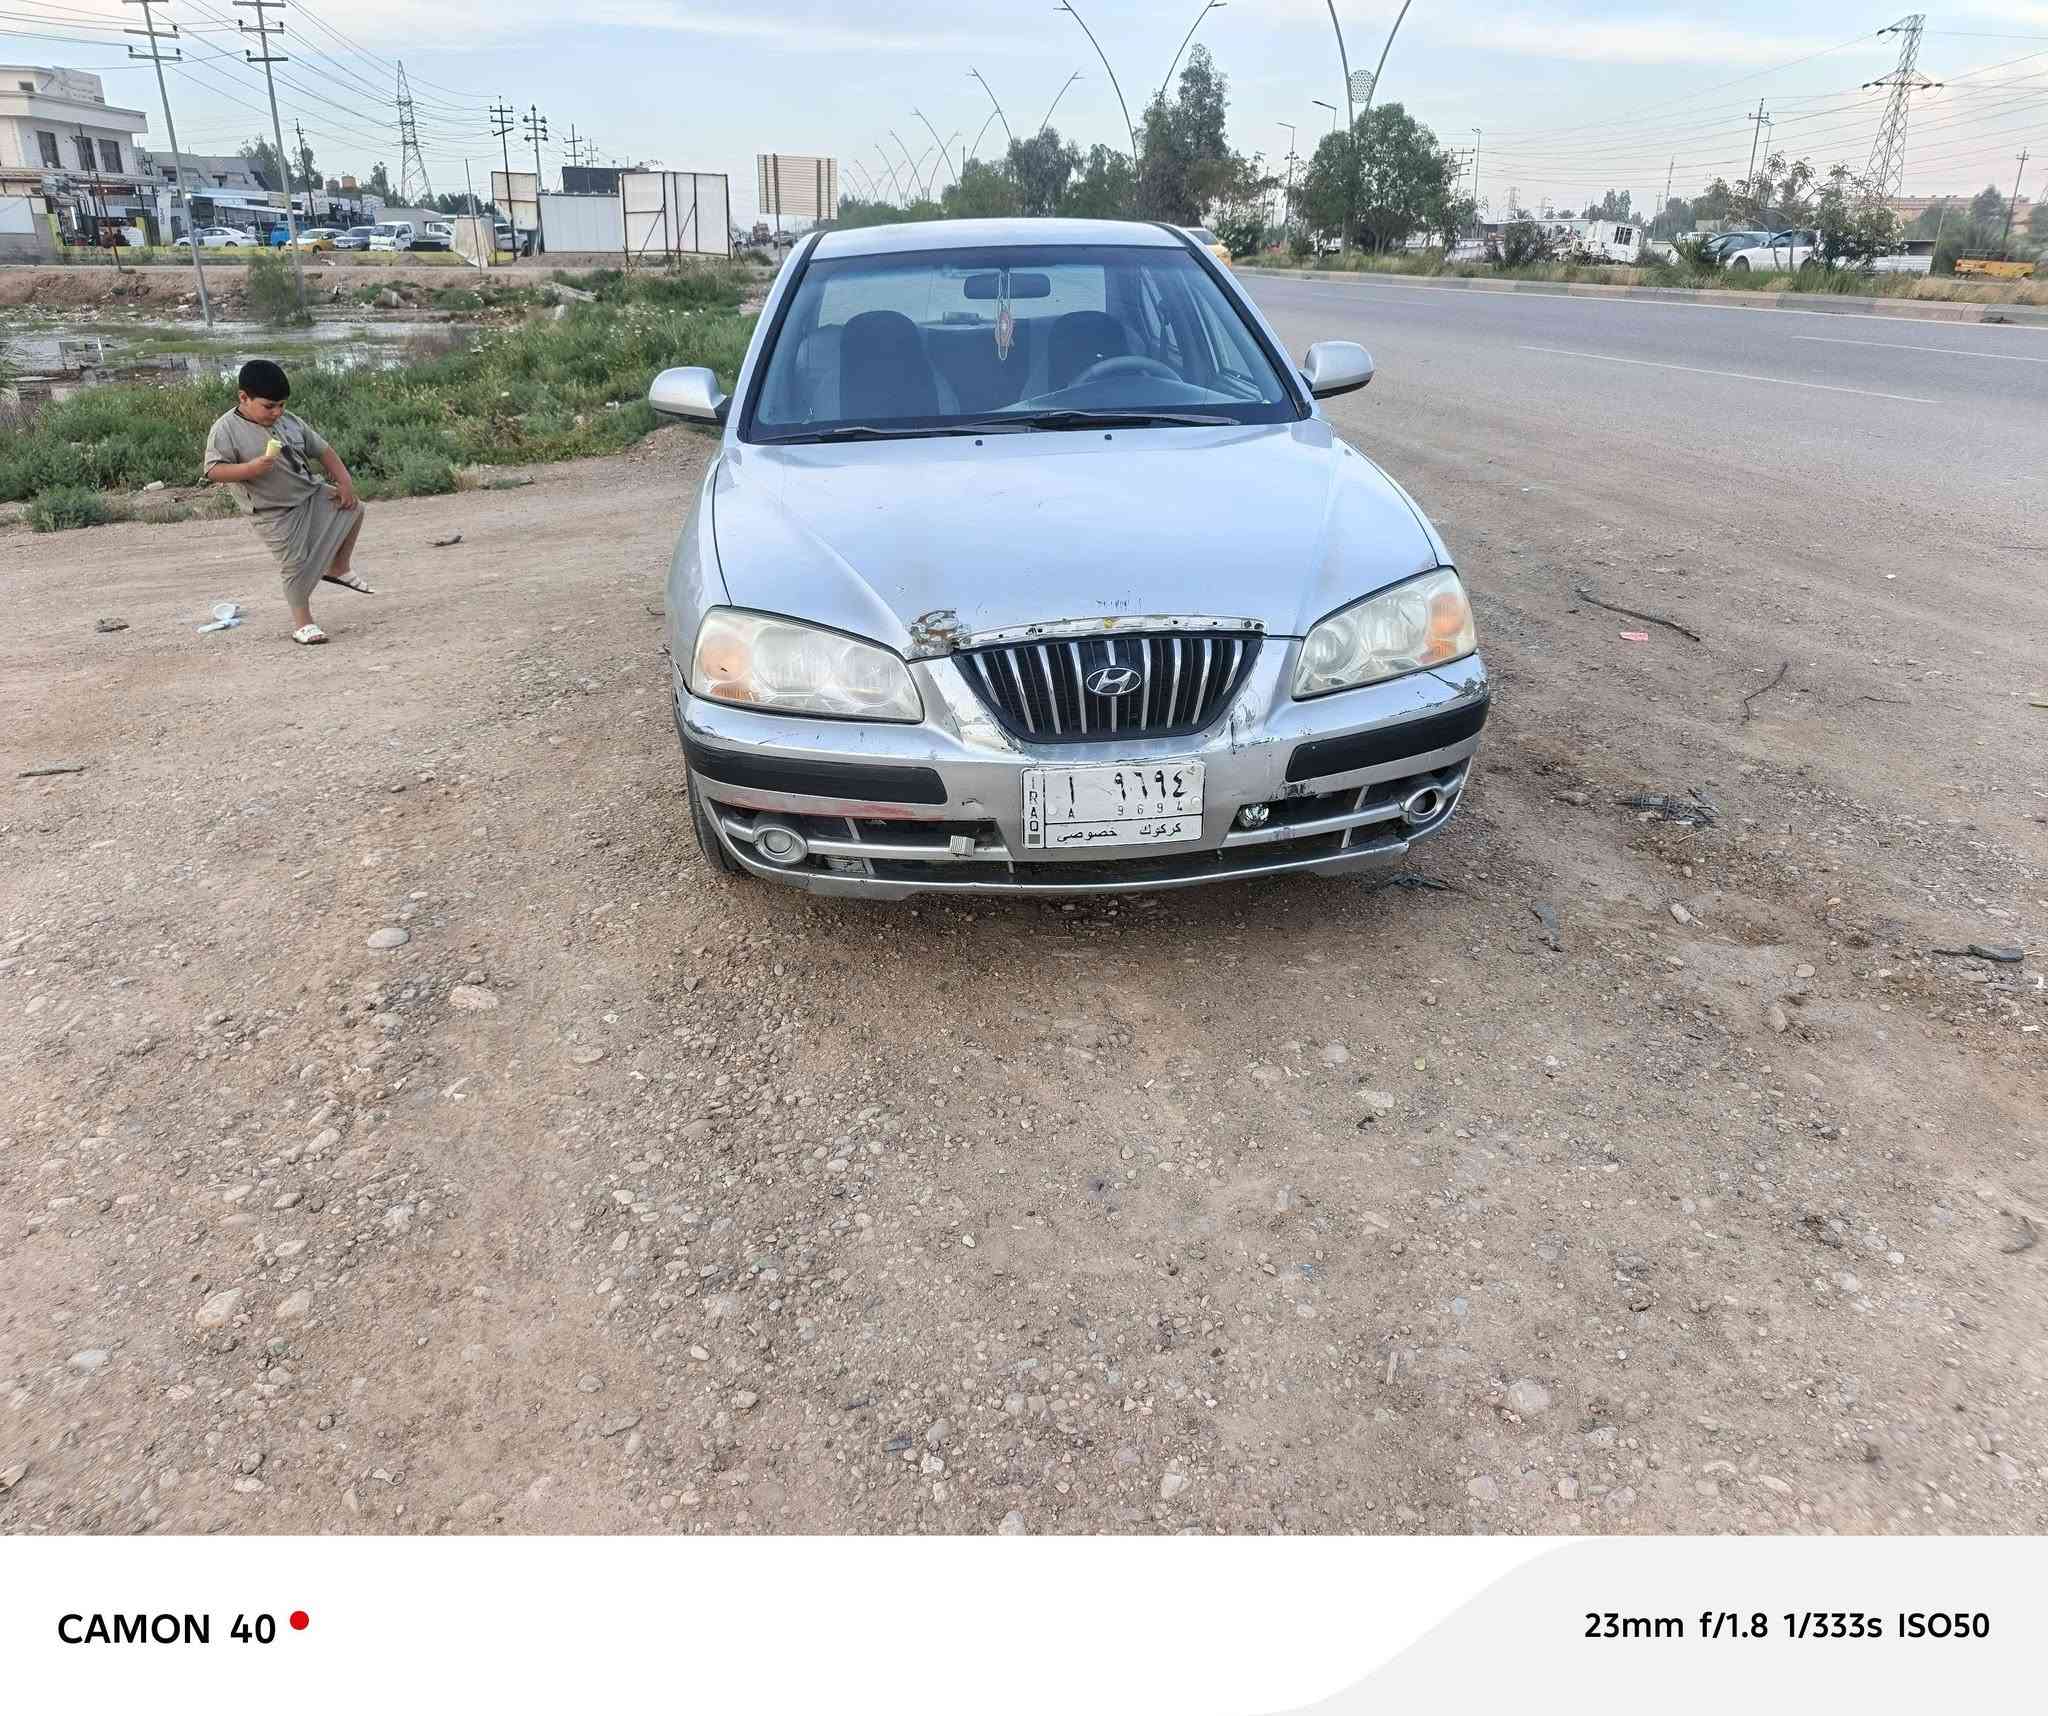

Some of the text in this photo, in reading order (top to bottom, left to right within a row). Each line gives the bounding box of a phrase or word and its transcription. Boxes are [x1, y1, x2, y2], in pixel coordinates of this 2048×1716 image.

[1028, 776, 1040, 833] IRAQ
[1067, 801, 1183, 819] A 9694
[1056, 821, 1182, 843] كركوك خصوصي
